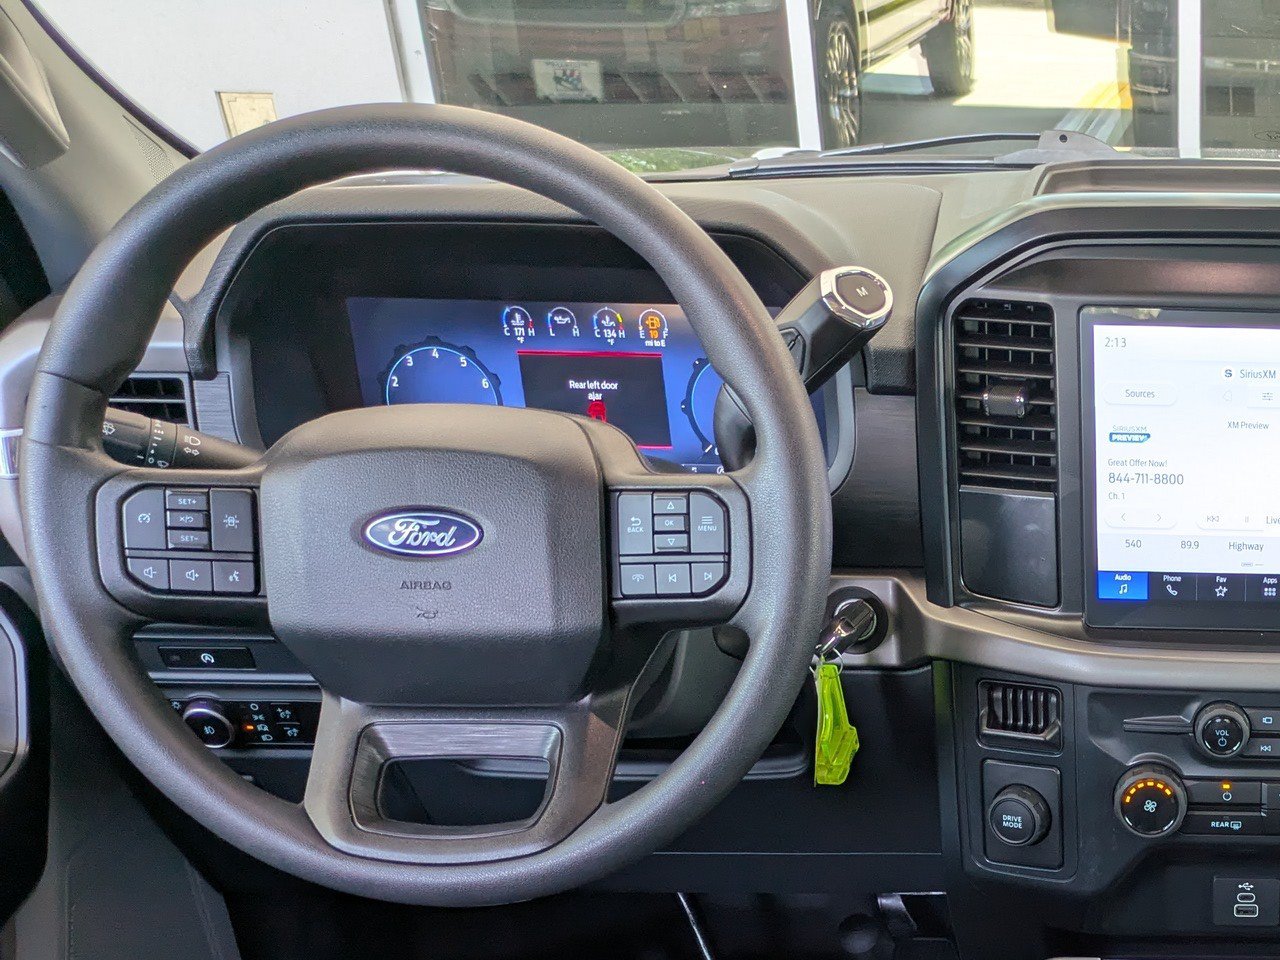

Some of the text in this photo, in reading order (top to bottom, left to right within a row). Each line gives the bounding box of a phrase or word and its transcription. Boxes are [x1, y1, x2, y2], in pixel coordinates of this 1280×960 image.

[856, 286, 868, 297] M
[514, 327, 525, 336] 171
[528, 328, 535, 336] H
[550, 328, 580, 337] L H
[603, 329, 617, 338] 134
[618, 330, 625, 338] H
[639, 330, 645, 339] E
[663, 331, 669, 339] F
[1104, 337, 1127, 348] 2:13
[432, 348, 439, 359] 4
[406, 356, 413, 366] 3
[460, 357, 467, 367] 5
[1240, 369, 1276, 379] SiriusXM
[391, 376, 399, 387] 2
[481, 378, 489, 389] 6
[569, 380, 618, 390] Rear left door
[588, 391, 602, 401] ajar
[1125, 389, 1155, 398] Sources
[1228, 421, 1269, 430] XM Preview
[1108, 459, 1168, 467] Great Offer Now!
[1108, 473, 1184, 485] 844-711-8800
[1108, 492, 1119, 500] Ch.
[388, 518, 457, 547] Ford
[1125, 539, 1142, 548] 540
[1180, 540, 1199, 549] 89.9
[1228, 542, 1264, 552] Highway
[1114, 573, 1131, 581] Audio
[1262, 577, 1278, 585] Apps
[400, 581, 451, 590] AIRBAG
